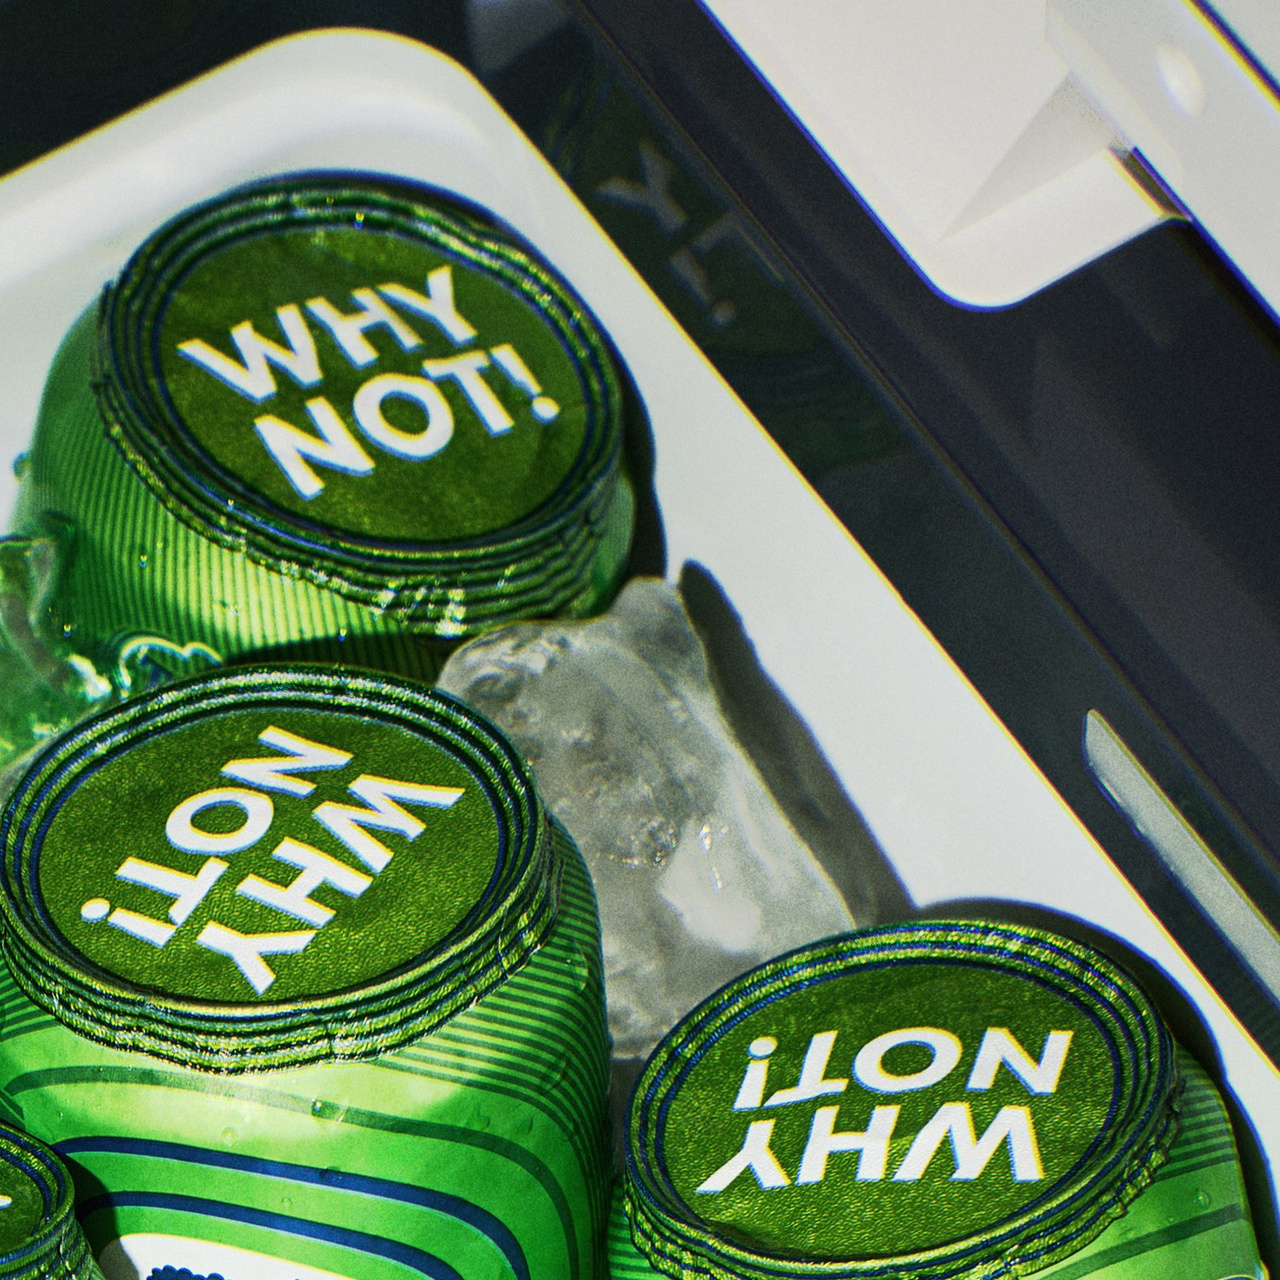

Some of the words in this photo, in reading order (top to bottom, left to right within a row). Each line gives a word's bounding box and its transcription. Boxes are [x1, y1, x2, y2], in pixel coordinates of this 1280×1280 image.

[177, 265, 477, 403] WHY
[254, 344, 561, 499] NOT!
[81, 725, 354, 949] NOT!
[196, 774, 465, 996] WHY
[732, 1027, 1075, 1112] NOT!
[694, 1102, 1045, 1194] WHY
